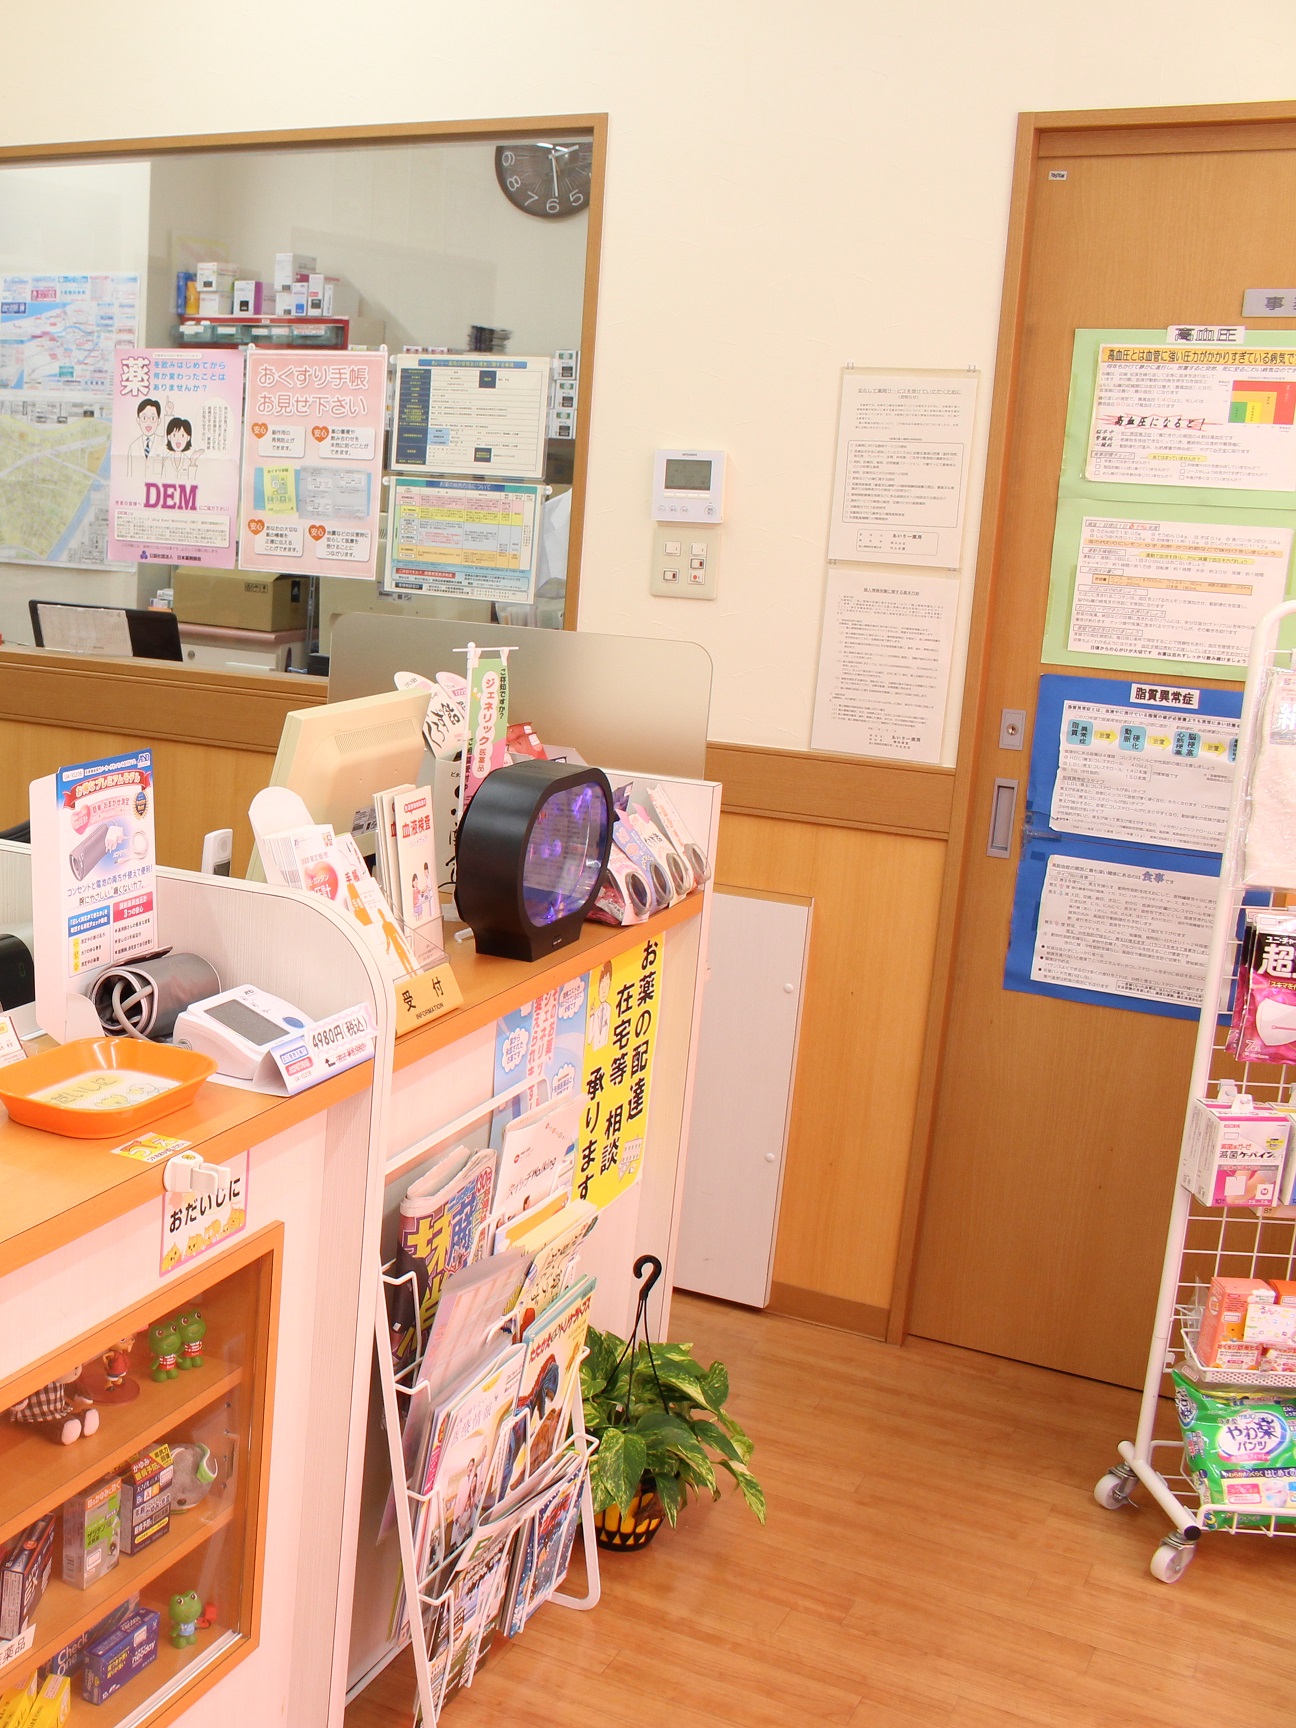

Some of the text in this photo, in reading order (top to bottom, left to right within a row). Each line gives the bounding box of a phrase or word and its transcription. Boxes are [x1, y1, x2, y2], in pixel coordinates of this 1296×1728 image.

[502, 152, 515, 166] 9
[507, 176, 521, 191] 8
[524, 191, 538, 206] 7
[546, 198, 559, 213] 6
[569, 189, 583, 206] 5
[1174, 327, 1238, 343] 高血圧
[153, 361, 226, 369] を飲みはじめてから
[1107, 349, 1296, 365] 高血圧とは血管に強い圧力がかかりすぎている病気で
[120, 357, 151, 396] 薬
[153, 372, 226, 381] 何か変わったことは
[257, 365, 369, 389] おくすり手帳
[153, 384, 207, 392] ありませんか？
[257, 394, 368, 416] お見せ下さい
[253, 426, 266, 434] 安心
[314, 429, 327, 438] 安心
[144, 483, 198, 510] DEM
[249, 522, 263, 531] 安心
[310, 528, 324, 537] 安心
[1135, 687, 1194, 706] 脂質異常症
[477, 679, 496, 772] ジェネリック医薬品
[1071, 721, 1080, 737] 脂質
[1078, 726, 1088, 746] 異常症
[1123, 727, 1132, 743] 動脈
[1131, 734, 1141, 750] 硬化
[1185, 733, 1197, 757] 脳梗塞
[402, 815, 431, 839] 血液検査
[1142, 871, 1165, 884] 食事
[402, 976, 444, 1013] 受付
[415, 1001, 444, 1021] INFORMATION
[312, 1014, 368, 1050] 4980円(税込)
[626, 939, 659, 1123] お薬の配達
[600, 981, 635, 1176] 在宅等 相談
[577, 1066, 605, 1201] 承ります
[170, 1177, 242, 1233] おだいじに
[1226, 1416, 1278, 1441] やわ楽
[1237, 1441, 1267, 1452] パンツ
[57, 1631, 89, 1666] Check
